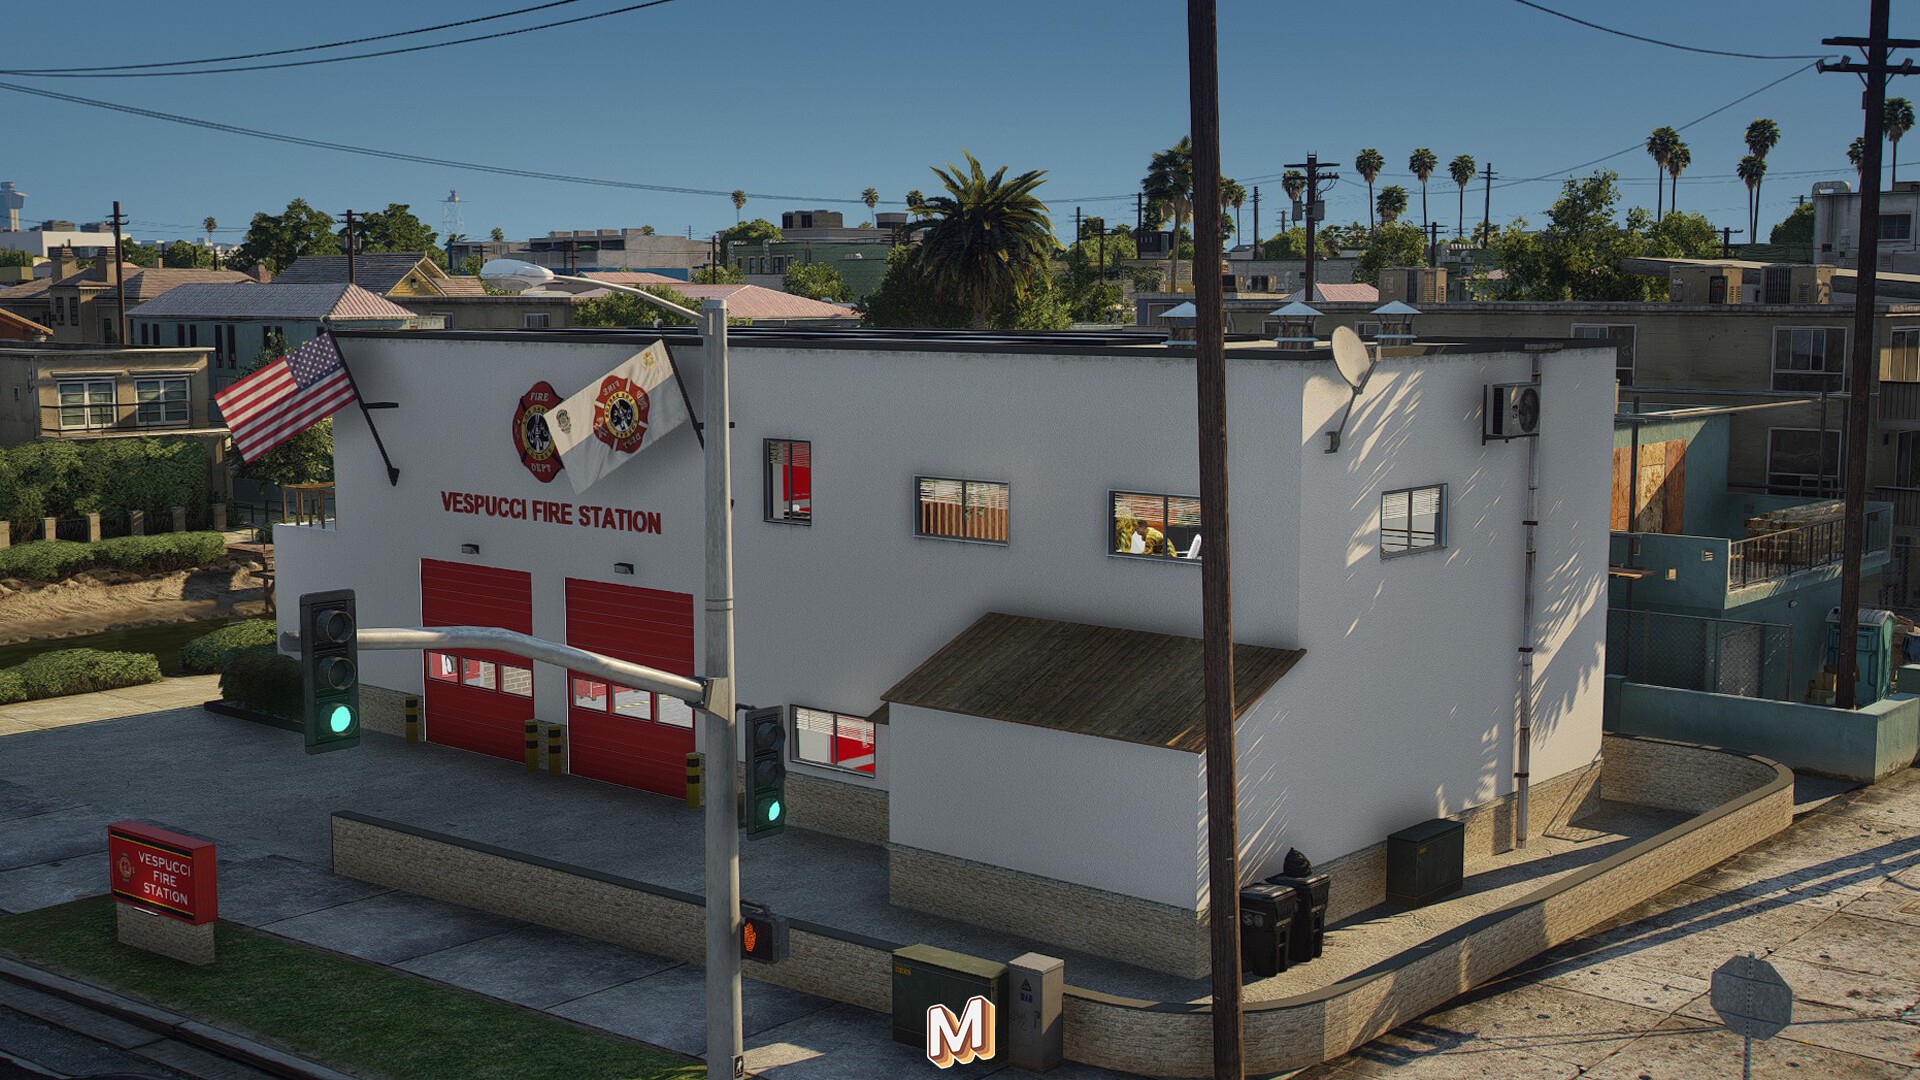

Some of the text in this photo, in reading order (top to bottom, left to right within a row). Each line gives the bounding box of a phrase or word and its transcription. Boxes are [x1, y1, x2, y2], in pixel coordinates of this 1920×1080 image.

[530, 393, 549, 402] FIRE
[531, 462, 551, 473] DEPT
[441, 491, 662, 534] VESPUCCI FIRE STATION
[138, 851, 191, 877] VESPUCCI
[153, 870, 177, 887] FIRE
[143, 882, 188, 905] STATION
